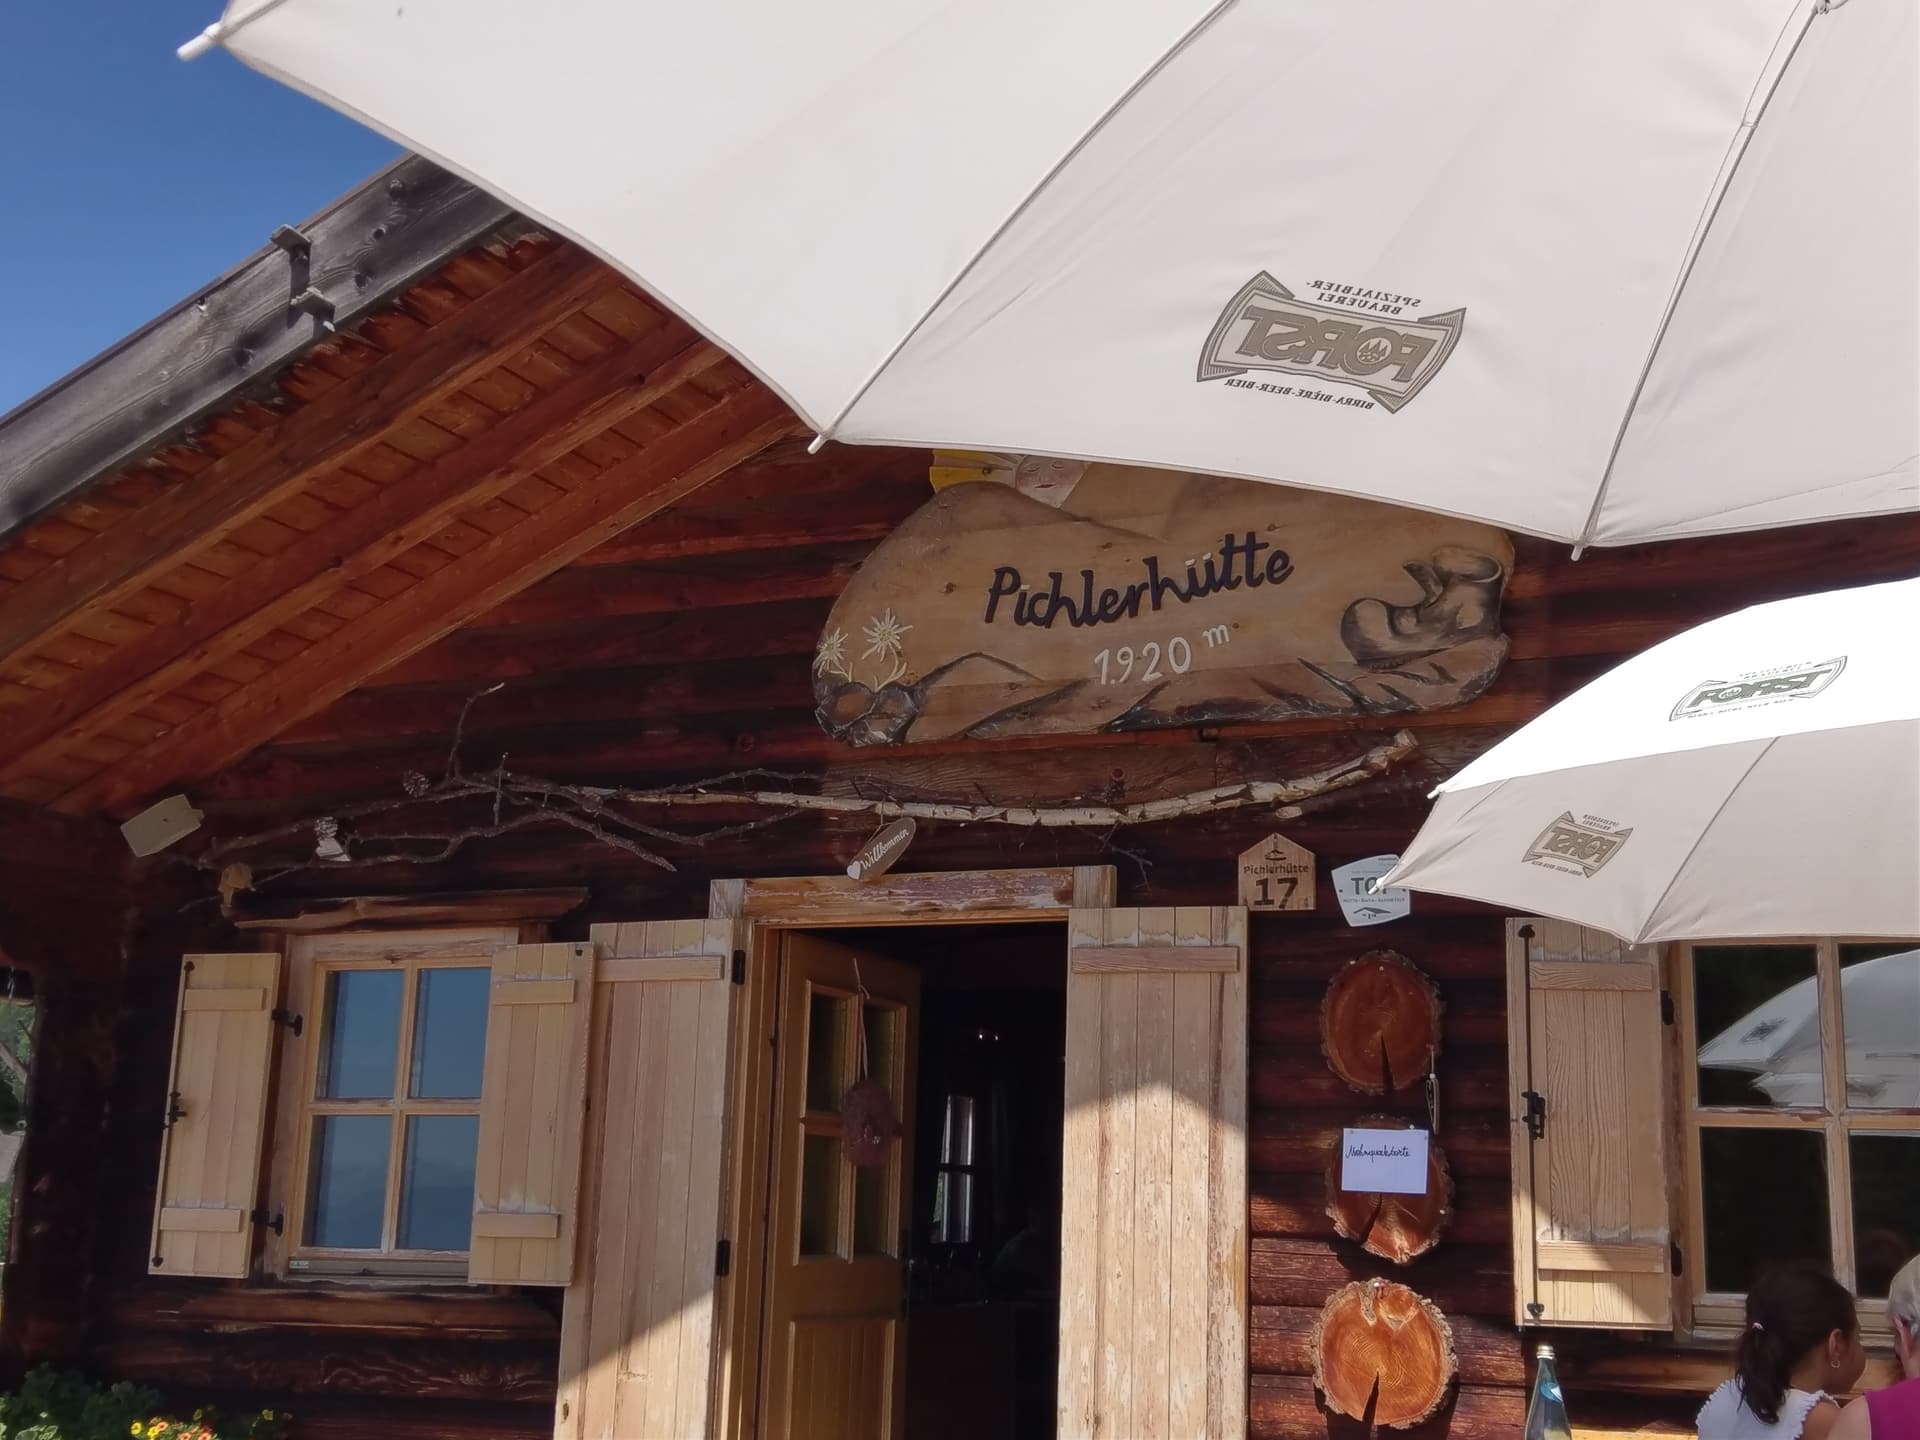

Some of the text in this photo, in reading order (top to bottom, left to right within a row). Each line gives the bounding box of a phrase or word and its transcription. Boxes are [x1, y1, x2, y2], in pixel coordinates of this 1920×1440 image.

[984, 530, 1295, 629] Pichlerhütte
[1201, 624, 1231, 648] m
[1685, 668, 1833, 709] FORST
[860, 828, 909, 871] Willkommen
[1243, 862, 1309, 875] Pichlerhütte
[1253, 876, 1299, 909] 17
[1350, 876, 1388, 896] TO
